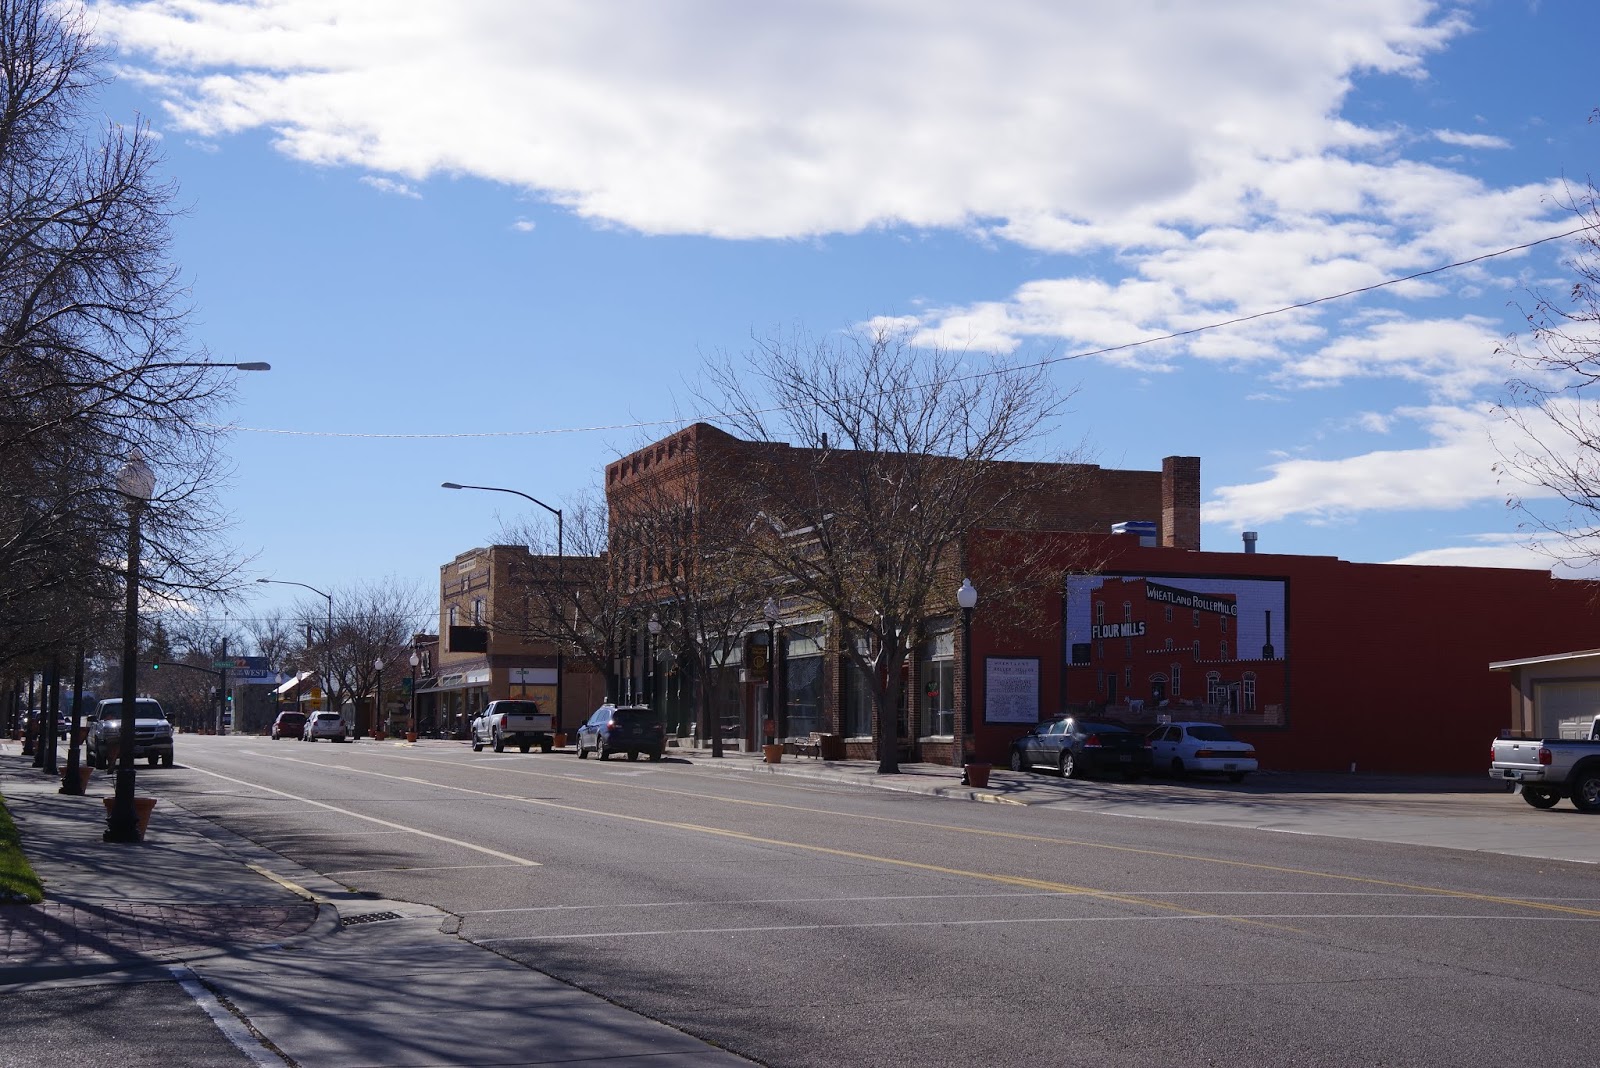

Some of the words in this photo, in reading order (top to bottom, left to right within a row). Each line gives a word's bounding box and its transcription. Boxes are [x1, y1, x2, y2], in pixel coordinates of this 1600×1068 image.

[1146, 585, 1192, 606] WHEATLAND
[1092, 624, 1119, 639] FLOUR
[1120, 621, 1145, 637] MILLS
